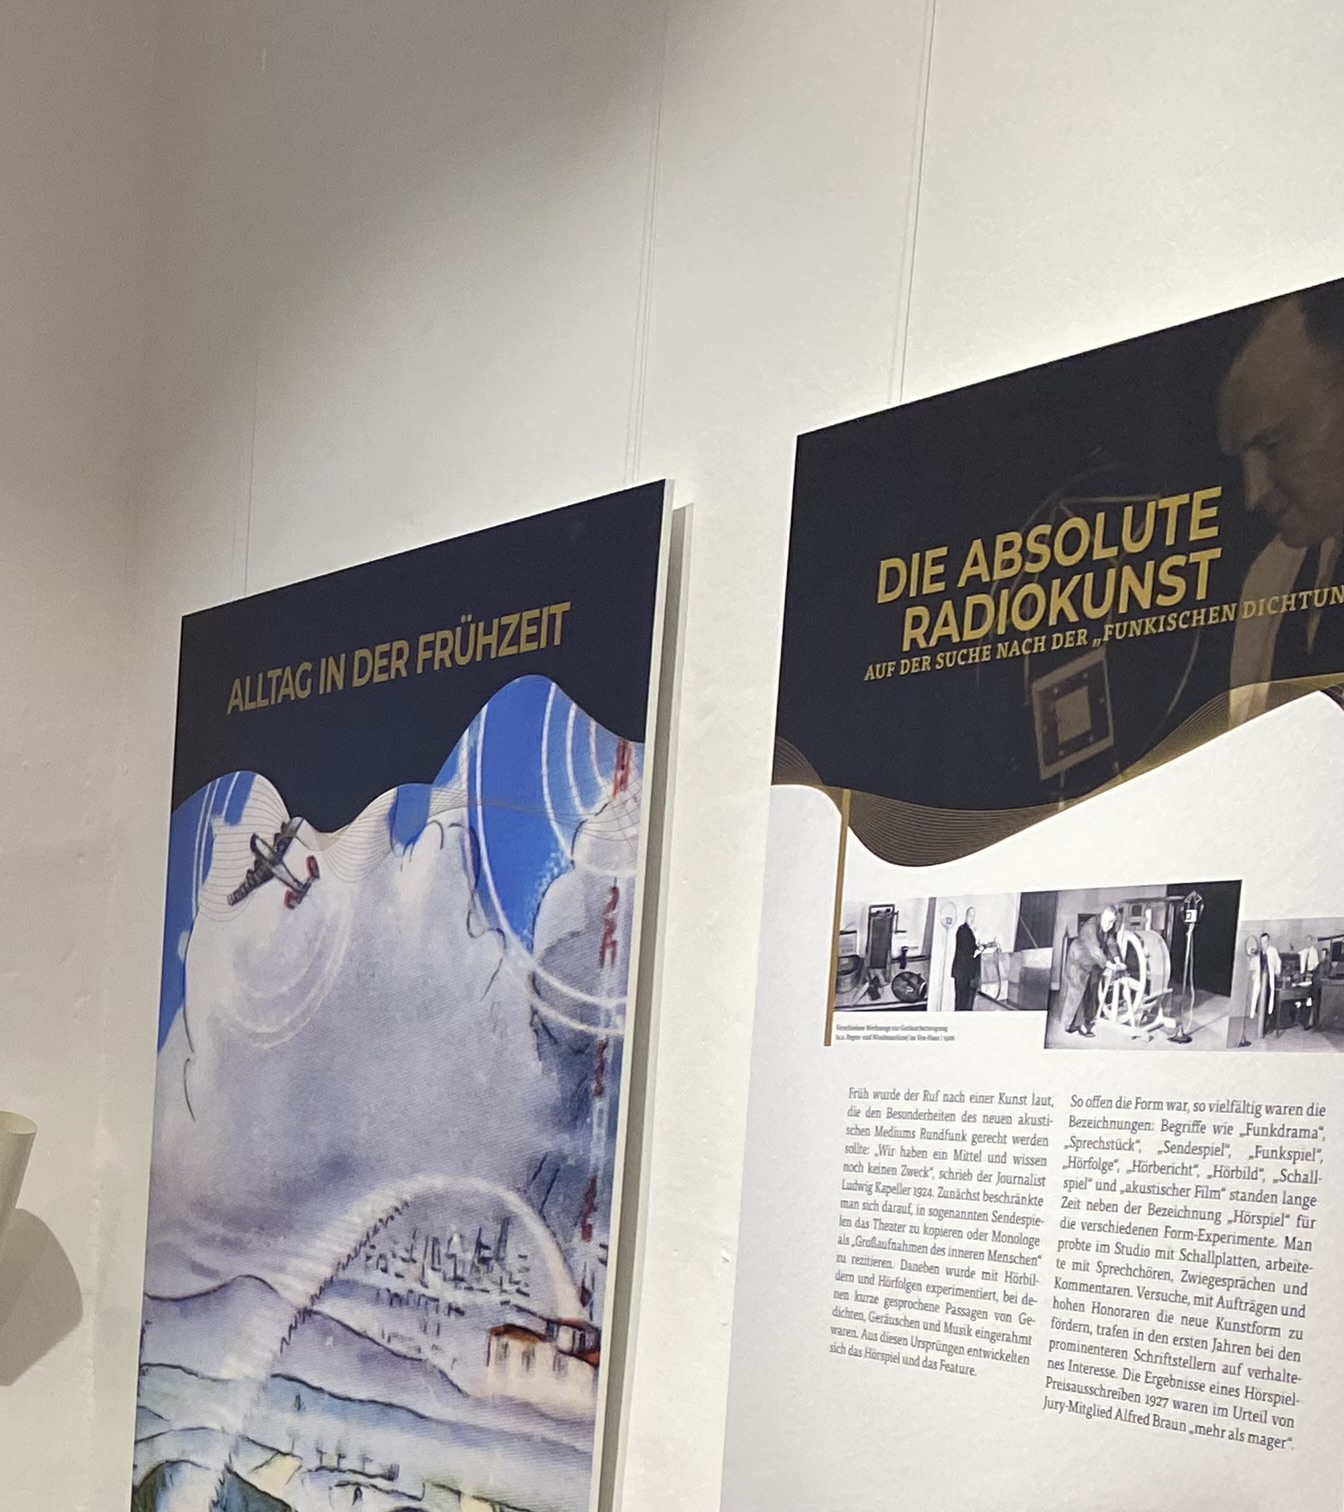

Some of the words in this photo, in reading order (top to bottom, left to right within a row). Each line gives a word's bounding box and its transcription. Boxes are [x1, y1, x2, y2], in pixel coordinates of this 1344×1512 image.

[877, 546, 949, 604] DIE
[957, 486, 1223, 588] ABSOLUTE
[902, 548, 1222, 652] RADIOKUNST
[227, 662, 313, 715] ALLTAG
[319, 653, 347, 695] IN
[352, 640, 409, 688] DER
[416, 602, 571, 674] FRÜHZEIT
[864, 662, 897, 682] AUF
[899, 656, 932, 676] DER
[936, 645, 992, 671] SUCHE
[996, 636, 1047, 660] NACH
[1051, 629, 1088, 650] DER
[1068, 1114, 1155, 1135] Bezeichnungen:
[1160, 1118, 1207, 1137] Begriffe
[1212, 1121, 1234, 1136] wie
[1070, 1094, 1084, 1108] So
[1085, 1095, 1113, 1109] offen
[1115, 1095, 1133, 1110] die
[1133, 1096, 1164, 1111] Form
[1166, 1101, 1190, 1114] war,
[1192, 1102, 1206, 1113] so
[1208, 1098, 1263, 1119] vielfältig
[1264, 1104, 1304, 1117] waren
[1306, 1101, 1327, 1118] die
